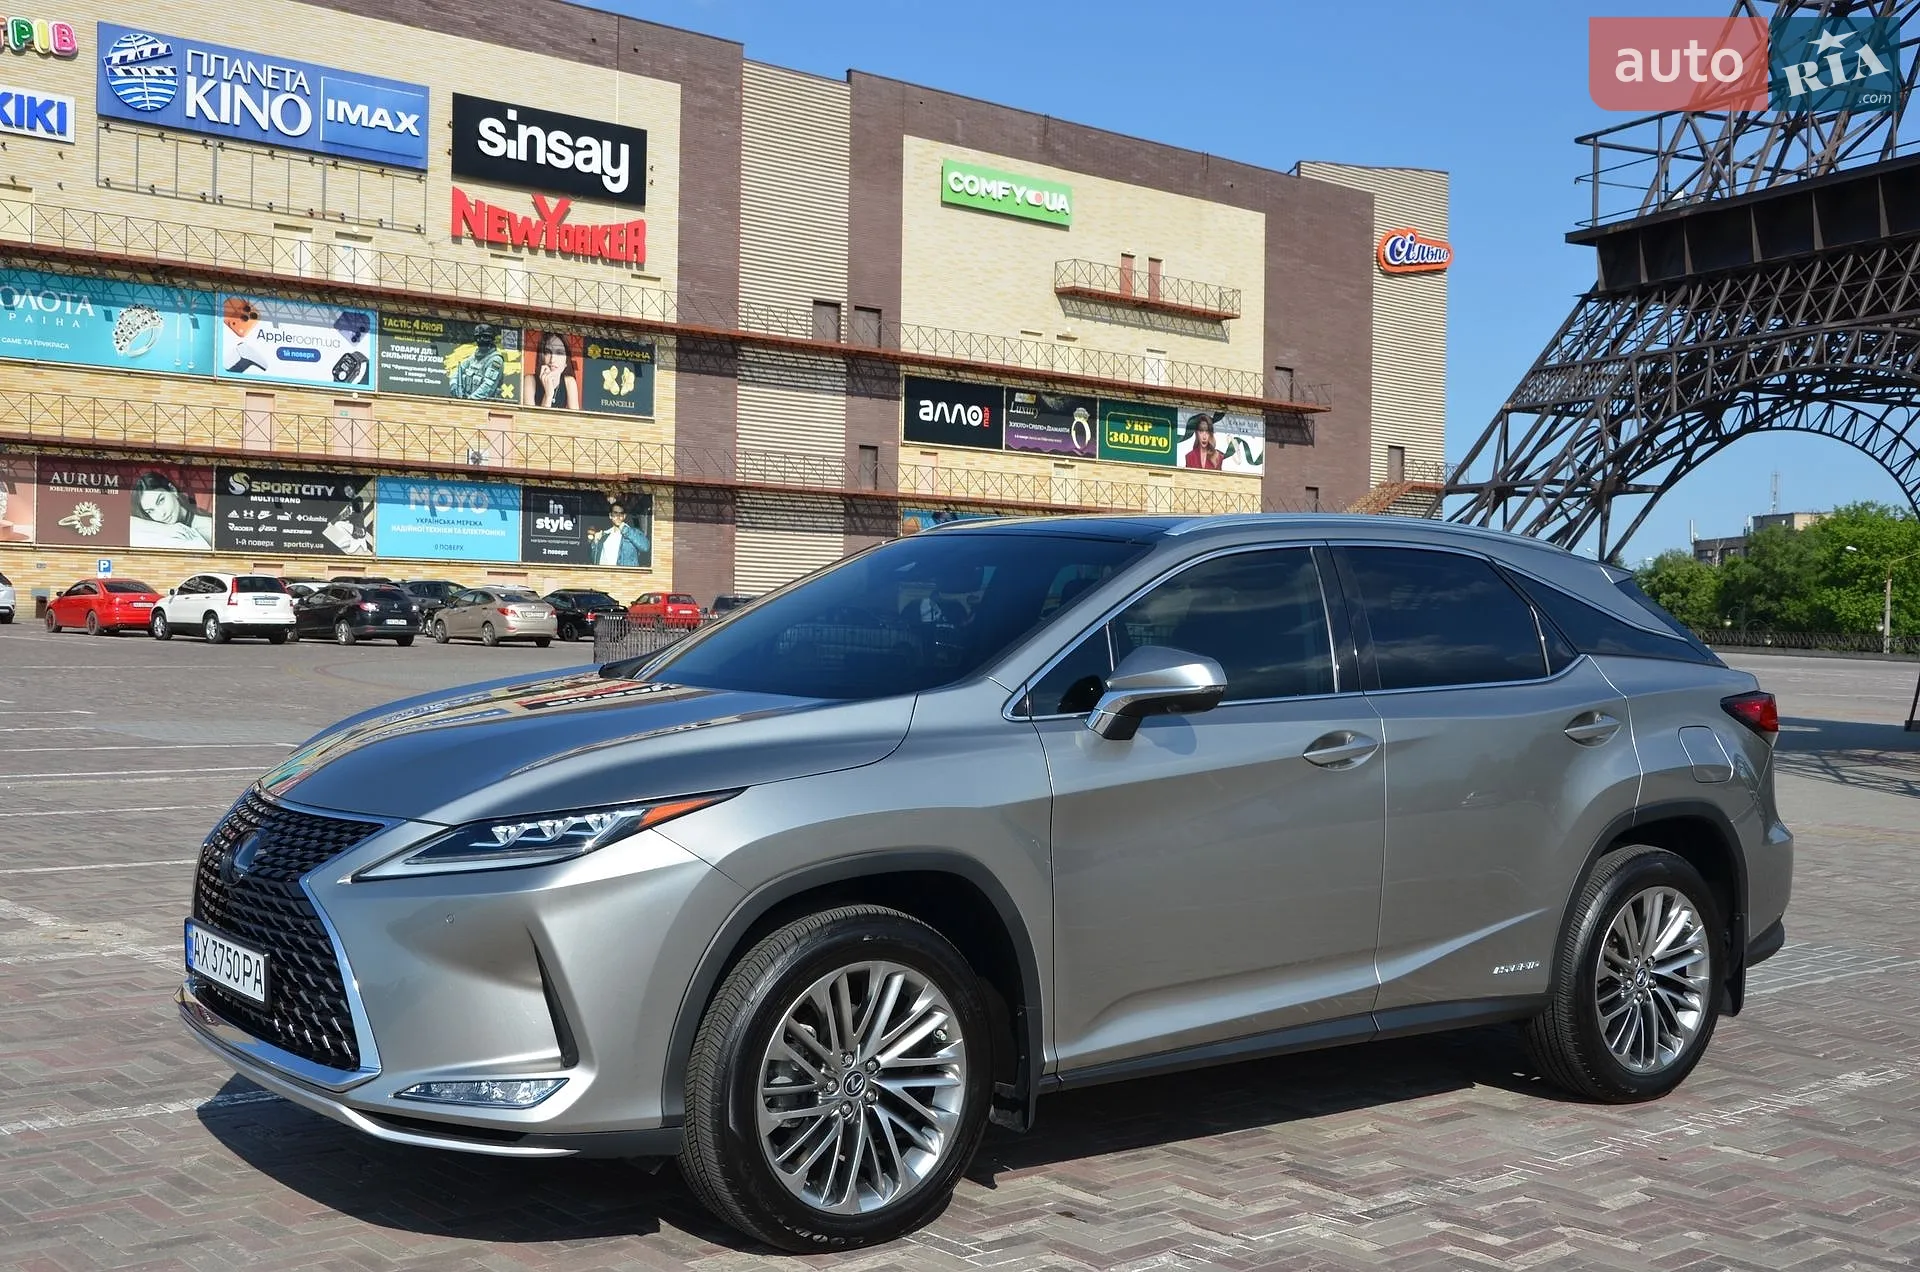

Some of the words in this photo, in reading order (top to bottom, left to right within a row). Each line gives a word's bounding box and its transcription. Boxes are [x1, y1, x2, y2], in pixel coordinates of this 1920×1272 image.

[185, 75, 312, 137] KINO
[326, 99, 421, 137] IMAX
[1385, 233, 1450, 265] Сільпо
[383, 317, 412, 329] TACTIC
[413, 319, 420, 330] 4
[34, 340, 70, 349] ПРИКРАСА
[257, 329, 341, 349] Appleroom.ua
[390, 344, 420, 354] ТОВАРИ
[603, 347, 651, 359] СТОЛИЧНА
[381, 351, 417, 361] СИЛЬНИХ
[418, 355, 444, 363] ДУХОМ
[601, 398, 635, 409] FRANCELLI
[1009, 401, 1039, 419] Luxury
[1125, 419, 1153, 432] УКР
[1109, 431, 1168, 448] ЗОЛОТО
[50, 471, 119, 487] AURUM
[251, 481, 335, 497] SPORTCITY
[250, 495, 301, 504] MULTIBRAND
[408, 485, 490, 514] MOYO
[549, 499, 564, 514] in
[283, 541, 324, 549] sportcity.ua
[100, 560, 109, 571] P
[194, 931, 209, 970] AX
[211, 939, 240, 984] 3750
[242, 953, 264, 995] PA
